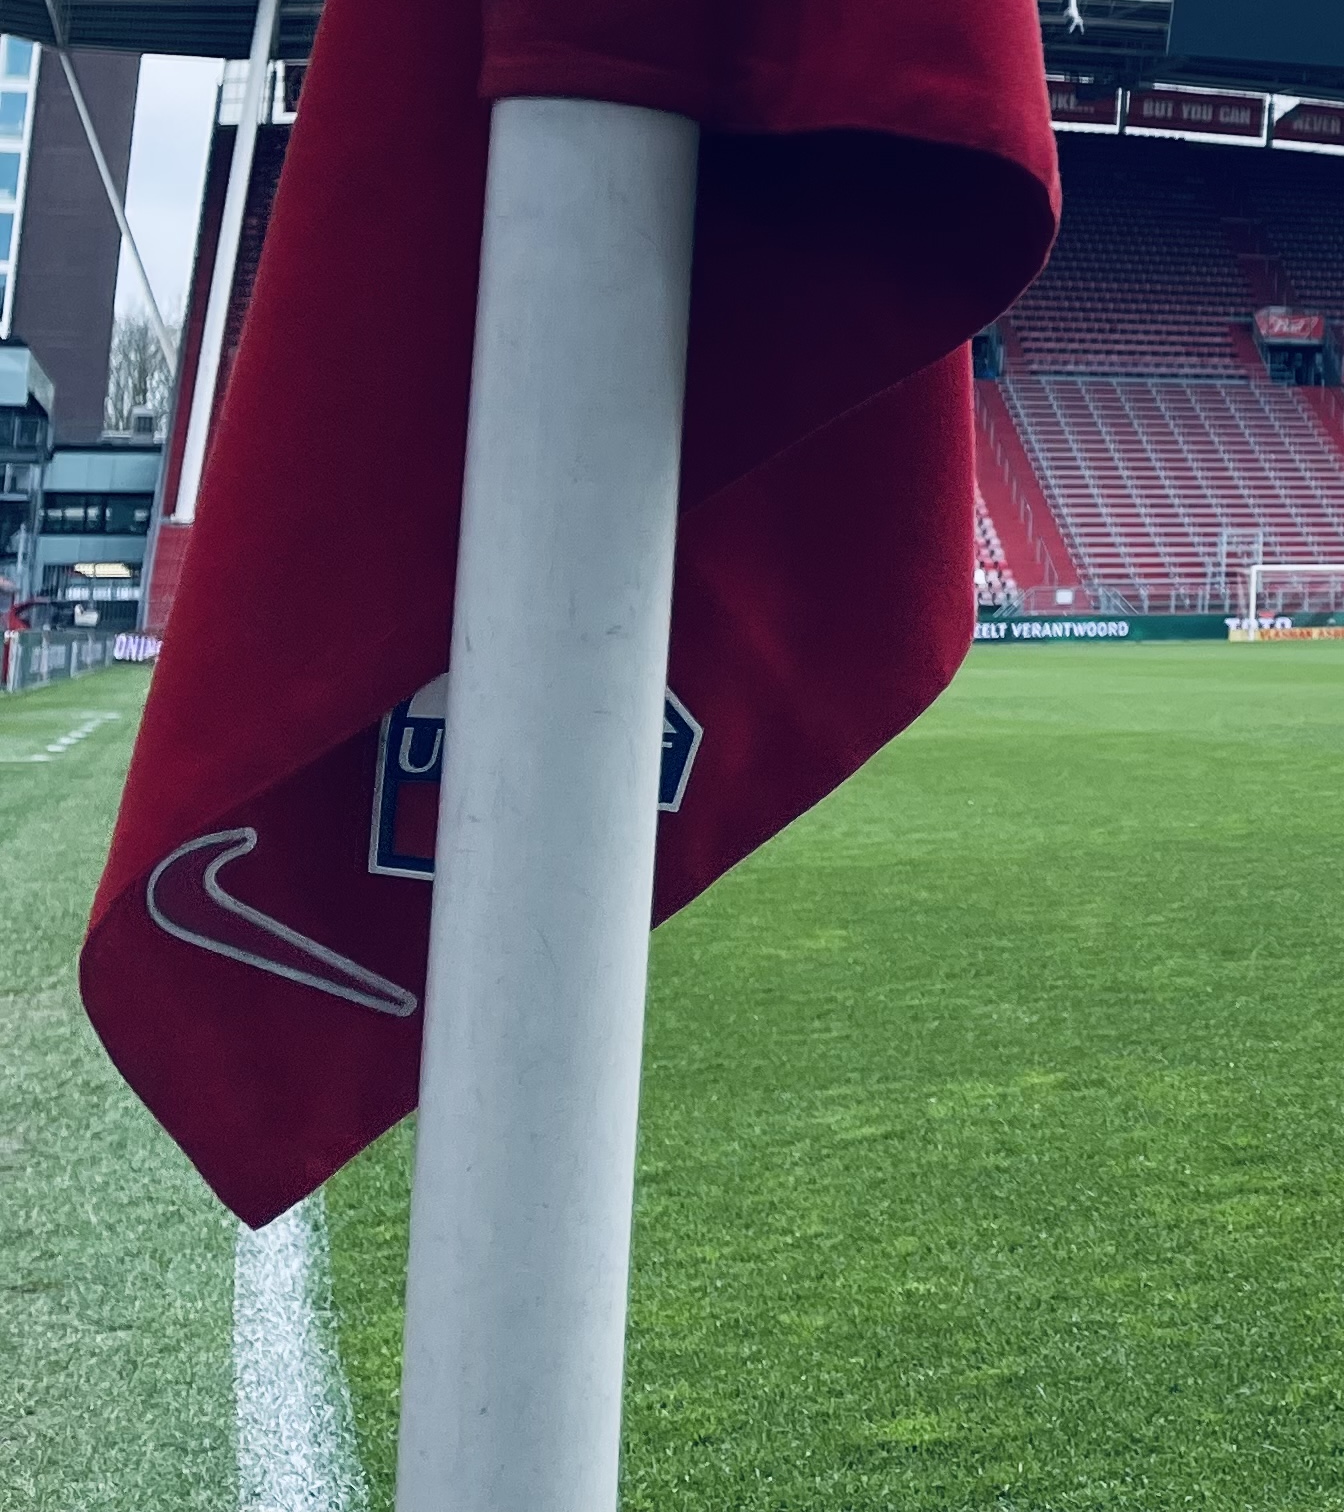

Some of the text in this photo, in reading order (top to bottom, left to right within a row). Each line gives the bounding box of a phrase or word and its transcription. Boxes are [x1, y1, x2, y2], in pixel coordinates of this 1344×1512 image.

[1142, 97, 1251, 125] BUT YOU CAN
[1011, 620, 1130, 638] VERANTWOORD
